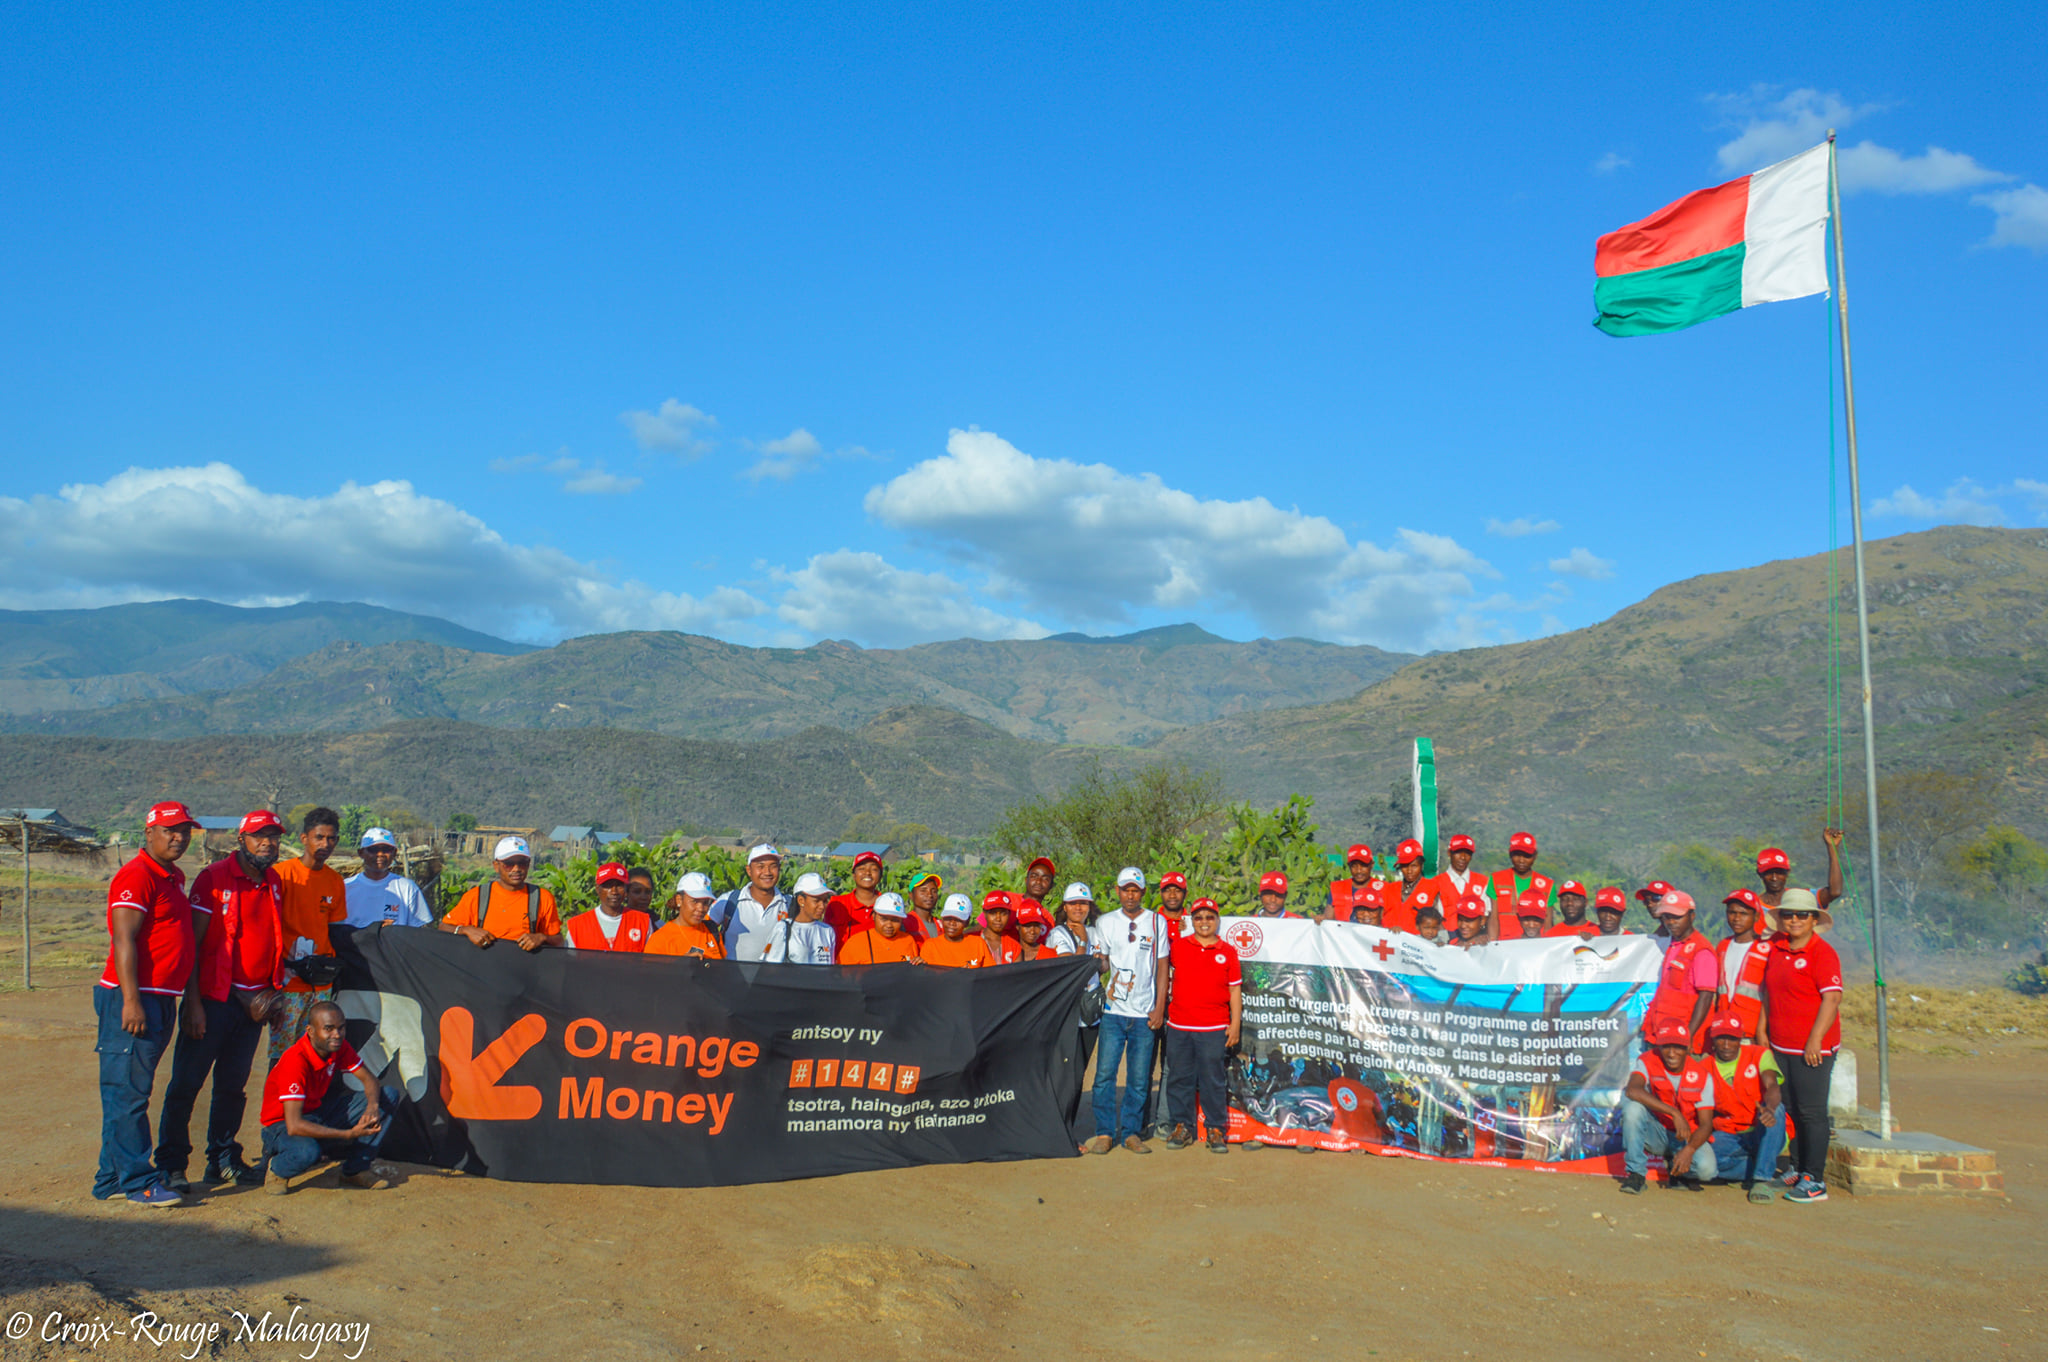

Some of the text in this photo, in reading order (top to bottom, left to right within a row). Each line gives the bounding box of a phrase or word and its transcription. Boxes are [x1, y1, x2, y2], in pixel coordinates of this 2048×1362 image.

[1241, 992, 1285, 1008] Soutien
[1288, 996, 1352, 1014] d'urgence
[1370, 1004, 1420, 1021] travers
[1423, 1012, 1441, 1023] un
[1444, 1011, 1528, 1031] Programme
[1531, 1019, 1549, 1032] de
[1551, 1017, 1619, 1031] Transfert
[1241, 1009, 1300, 1024] Monetaire
[1358, 1020, 1407, 1037] l'accès
[1411, 1025, 1419, 1038] à
[1423, 1027, 1457, 1042] l'eau
[1460, 1032, 1494, 1046] pour
[1496, 1033, 1519, 1048] les
[1523, 1034, 1608, 1051] populations
[564, 1017, 760, 1078] Orange
[792, 1025, 883, 1045] antsoy ny
[1257, 1026, 1583, 1066] affectées par la sécheresse dans le district de
[1280, 1042, 1347, 1064] Tolagnaro,
[1349, 1053, 1392, 1068] région
[1396, 1058, 1454, 1078] d'Anosy,
[1458, 1064, 1548, 1083] Madagascar
[558, 1077, 734, 1136] Money
[787, 1098, 845, 1113] tsotra,
[851, 1097, 934, 1117] haingana,
[940, 1099, 970, 1109] azo
[787, 1113, 986, 1133] manamora ny fiainanao
